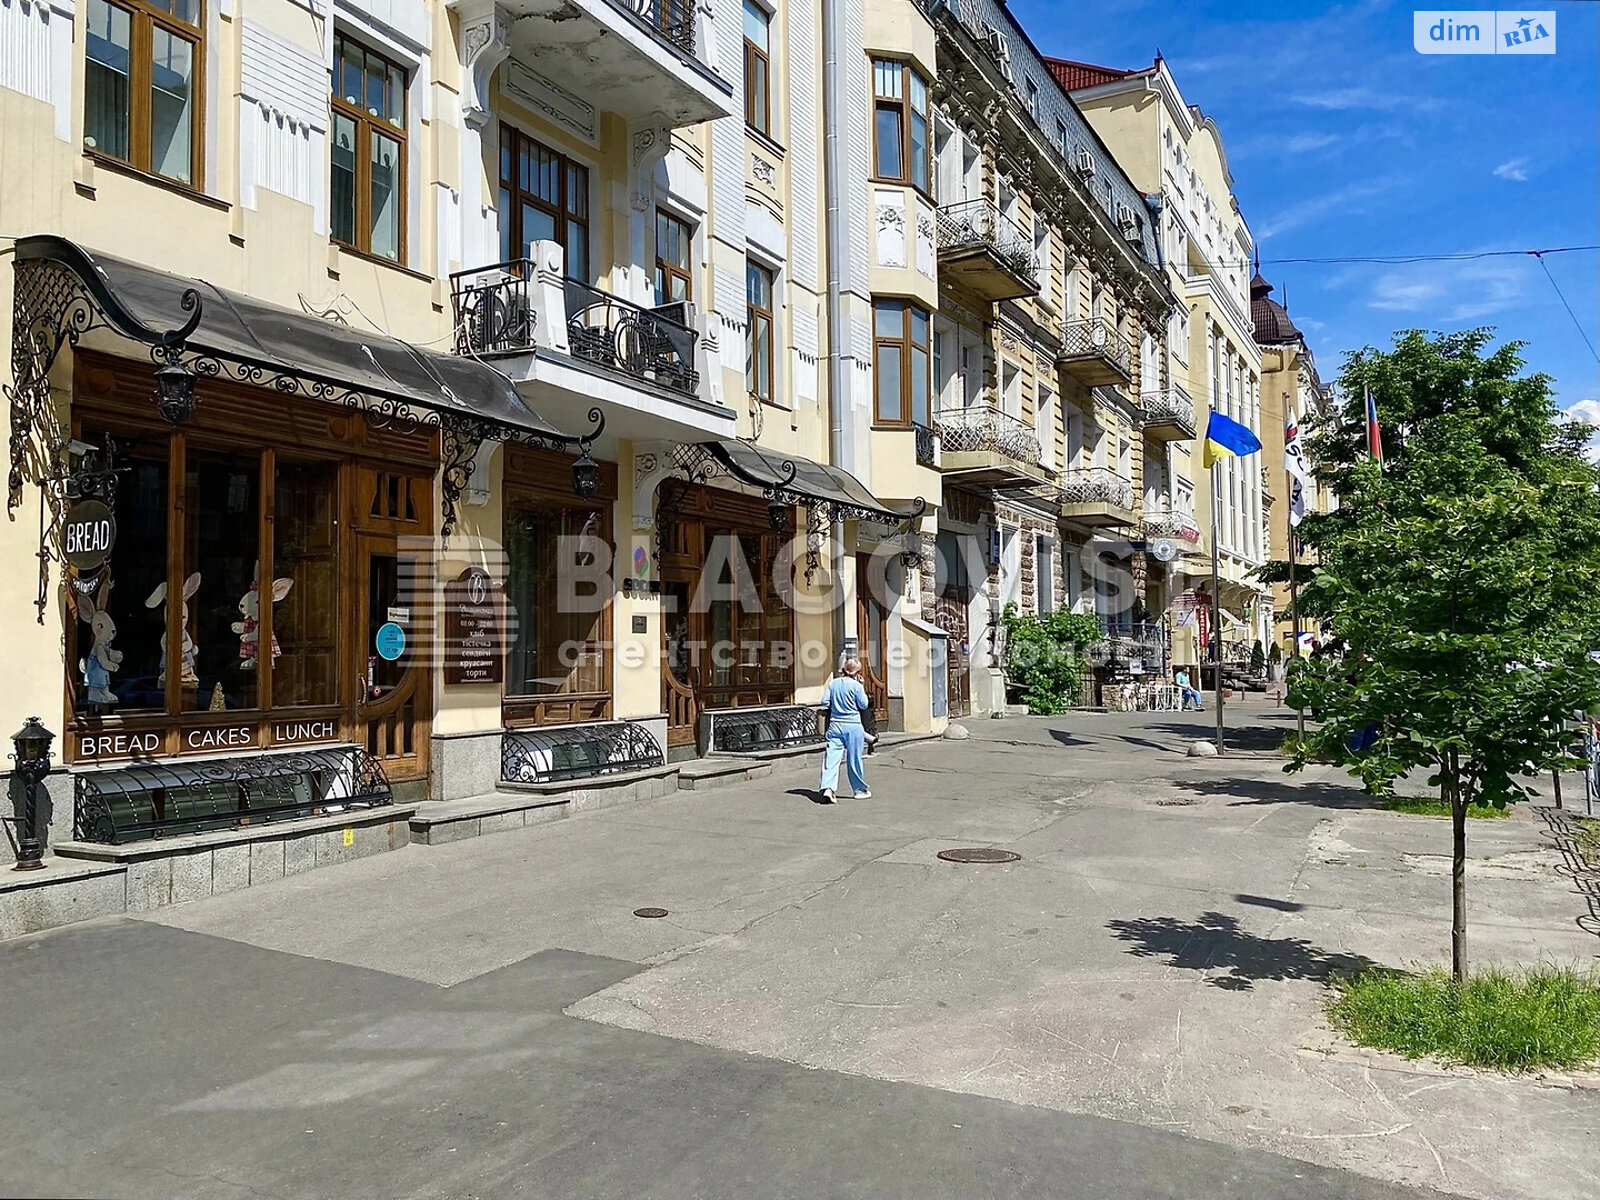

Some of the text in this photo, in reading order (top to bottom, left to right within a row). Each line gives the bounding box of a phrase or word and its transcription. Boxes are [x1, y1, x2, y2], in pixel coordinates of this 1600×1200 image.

[66, 520, 110, 554] BREAD
[80, 721, 334, 756] BREAD CAKES LUNCH
